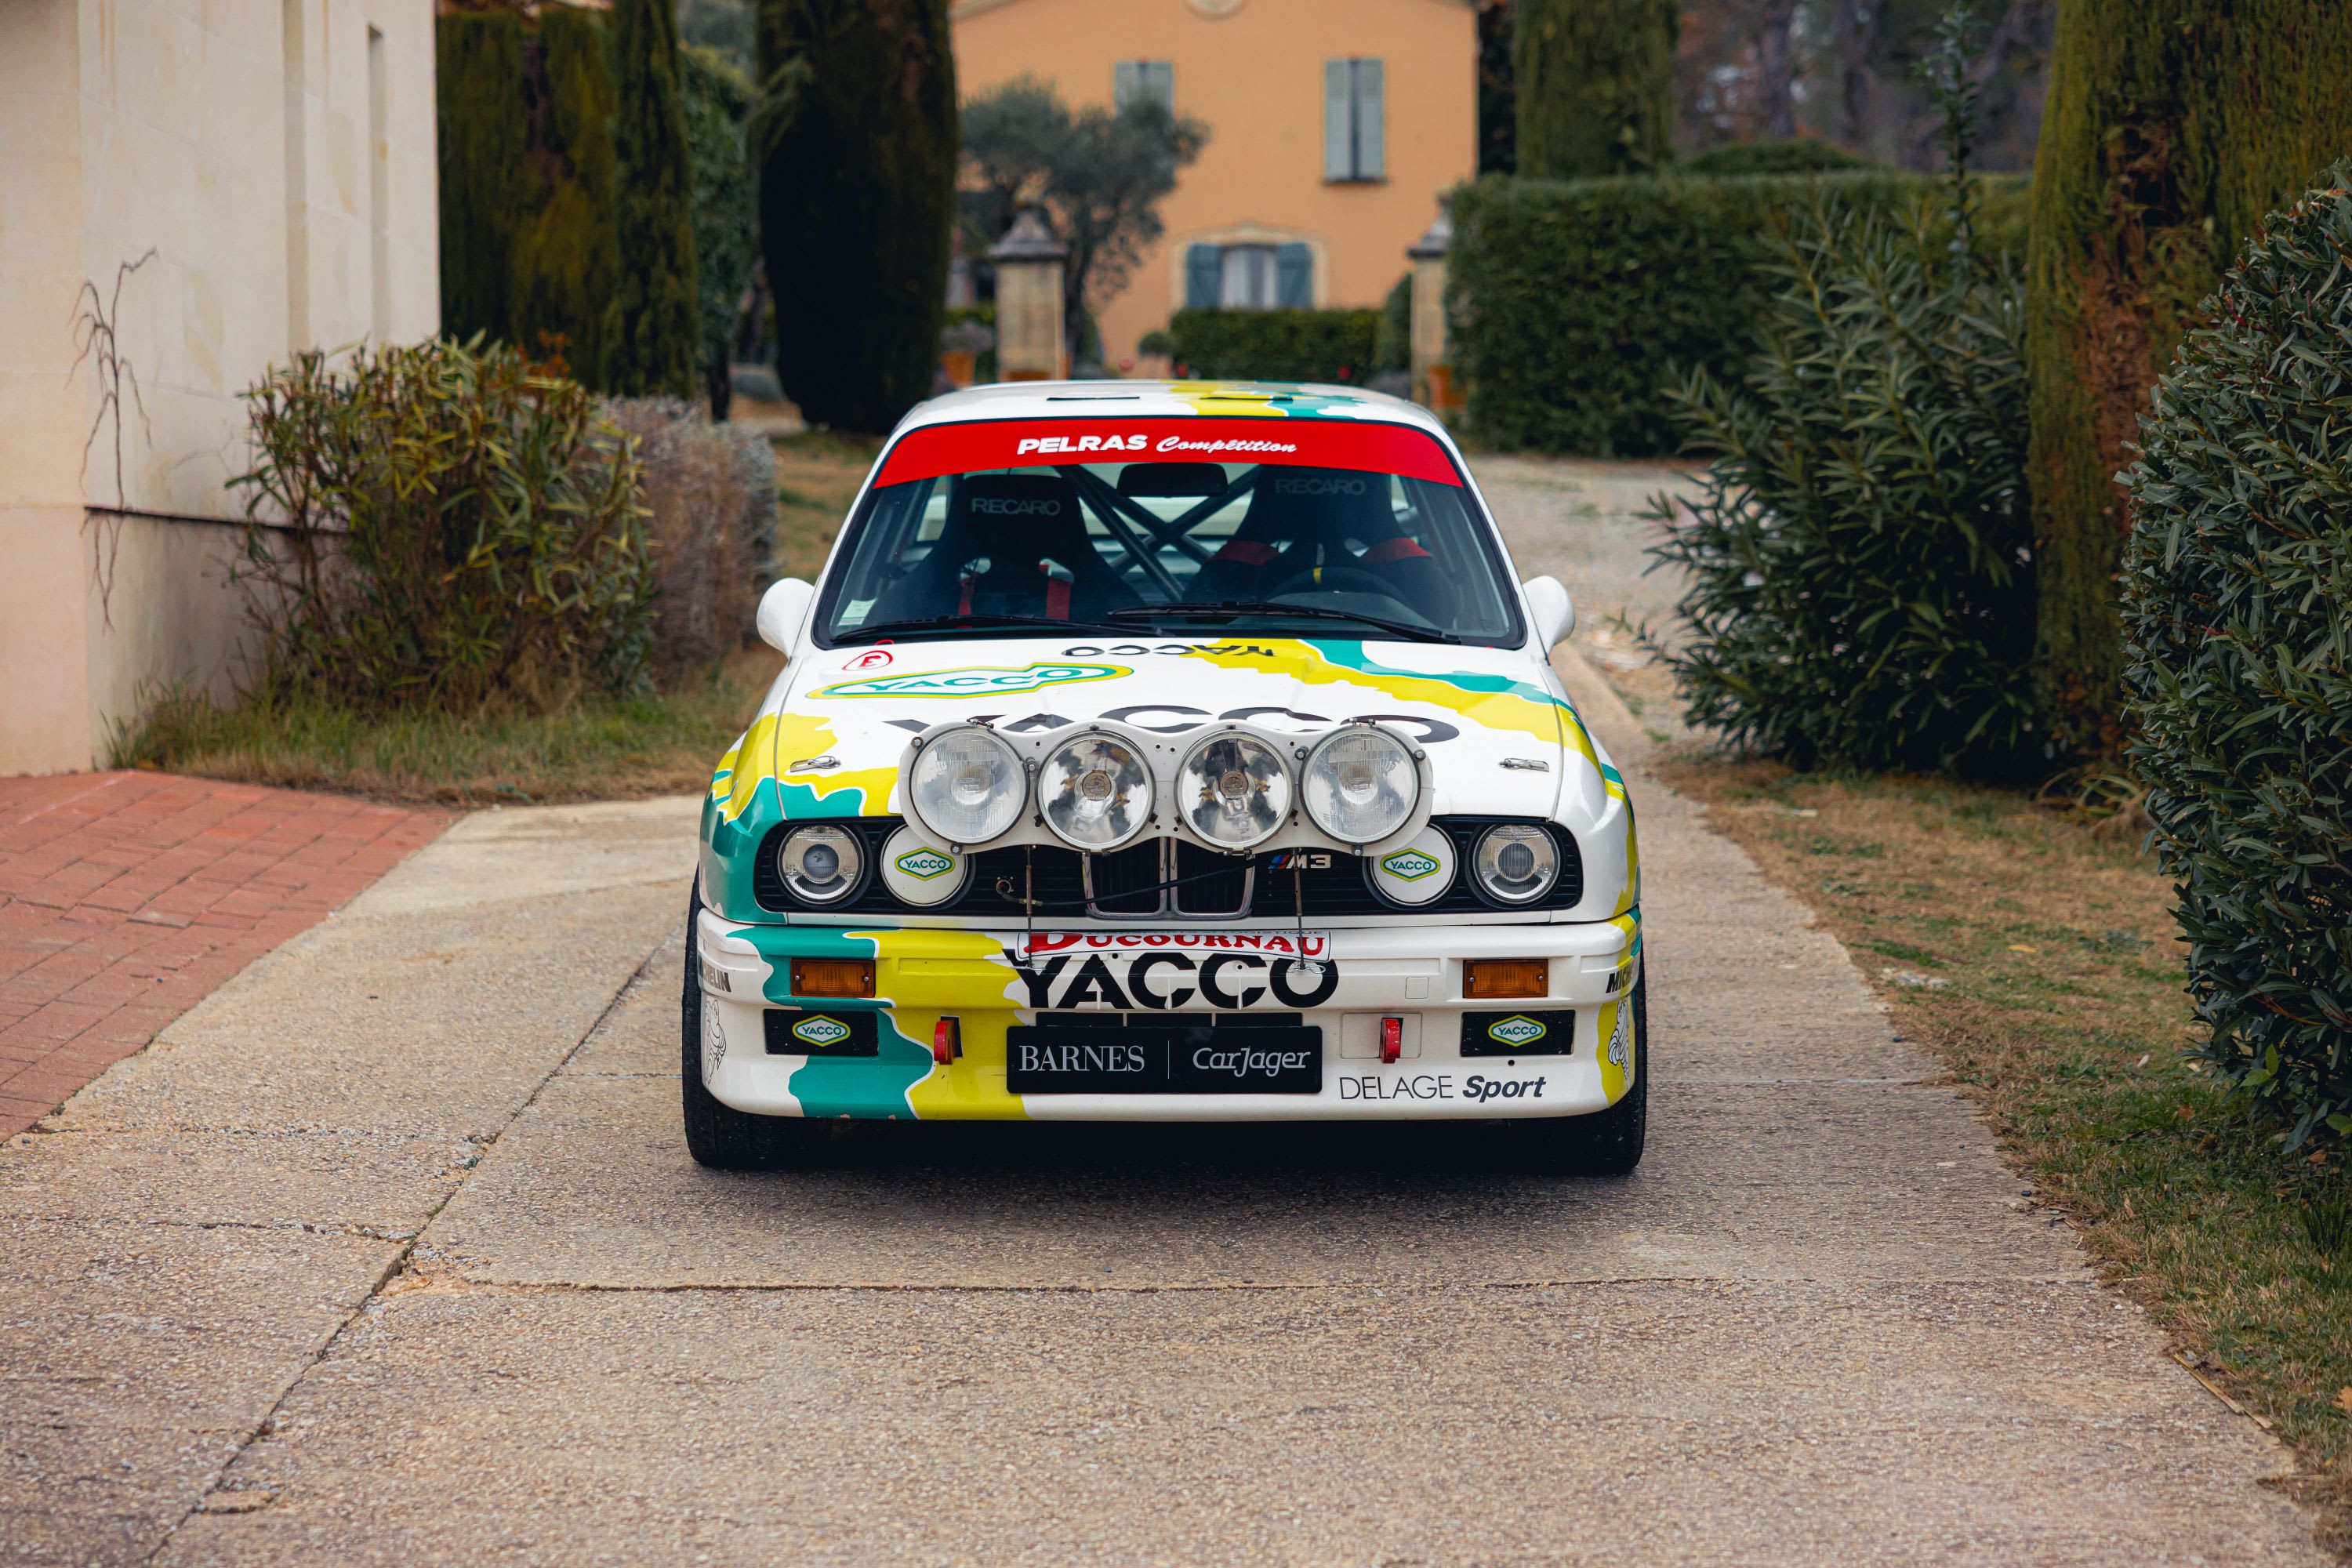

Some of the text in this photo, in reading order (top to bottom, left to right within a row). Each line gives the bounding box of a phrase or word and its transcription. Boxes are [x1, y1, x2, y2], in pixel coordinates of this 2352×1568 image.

[1017, 434, 1148, 455] PELRAS
[1275, 478, 1366, 495] RECARO
[971, 498, 1061, 516] RECARO
[1061, 644, 1276, 656] YACCO
[864, 669, 1083, 691] YACCO
[904, 859, 947, 869] YACCO
[1286, 854, 1331, 869] M3
[1389, 860, 1432, 870] YACCO
[1002, 948, 1339, 1010] YACCO
[801, 1025, 842, 1036] YACCO
[1497, 1025, 1538, 1036] YACCO
[1018, 1045, 1311, 1077] BARNES CarJager
[1339, 1075, 1546, 1103] DELAGE Sport
